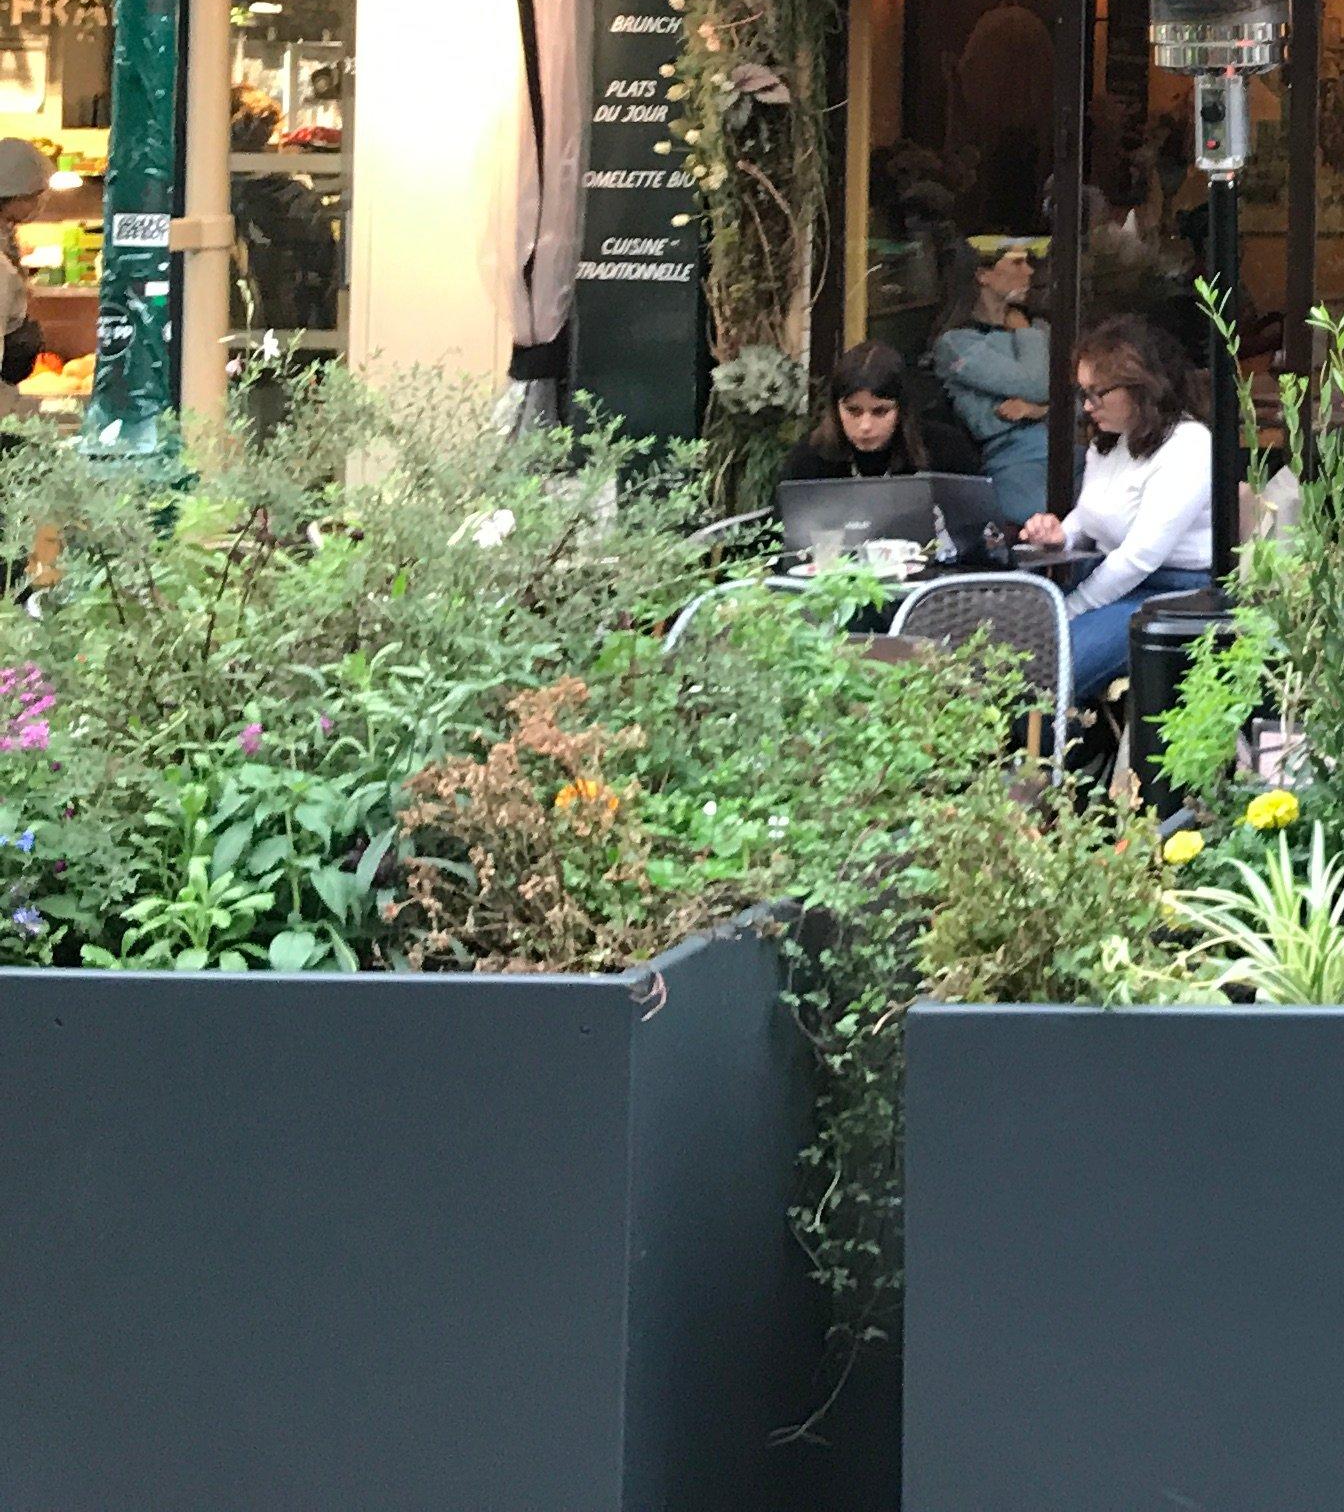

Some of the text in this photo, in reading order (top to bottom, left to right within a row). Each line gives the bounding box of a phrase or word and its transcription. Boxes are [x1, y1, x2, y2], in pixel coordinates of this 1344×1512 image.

[610, 15, 682, 33] BRUNCH
[604, 80, 658, 98] PLATS
[593, 105, 669, 122] DU JOUR
[582, 170, 667, 188] OMELETTE
[601, 237, 669, 255] CUISINE
